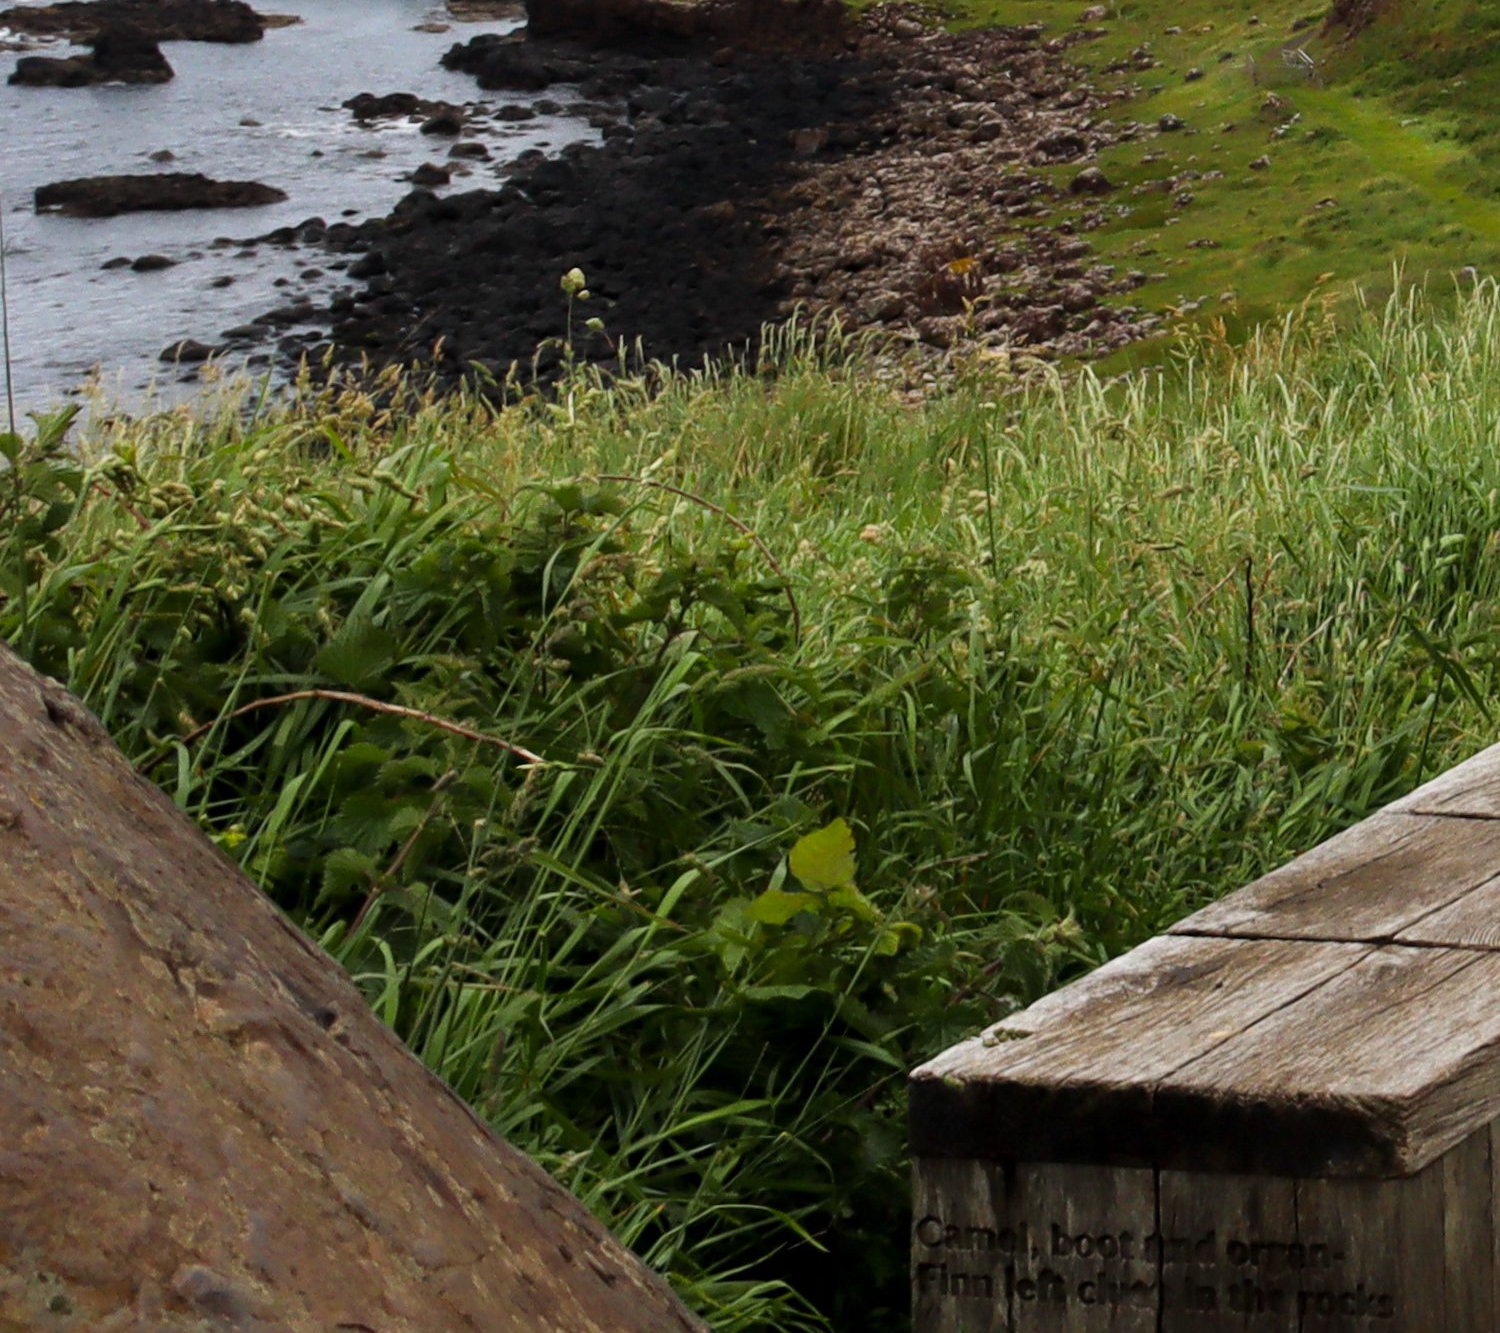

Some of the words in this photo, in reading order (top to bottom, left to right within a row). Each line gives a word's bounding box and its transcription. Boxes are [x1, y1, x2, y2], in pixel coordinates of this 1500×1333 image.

[1051, 1222, 1135, 1260] boot
[1144, 1229, 1217, 1264] and
[917, 1262, 994, 1298] Finn
[1004, 1266, 1068, 1303] left
[1184, 1275, 1217, 1311] in
[1229, 1278, 1285, 1315] the
[1297, 1283, 1395, 1318] rocks
